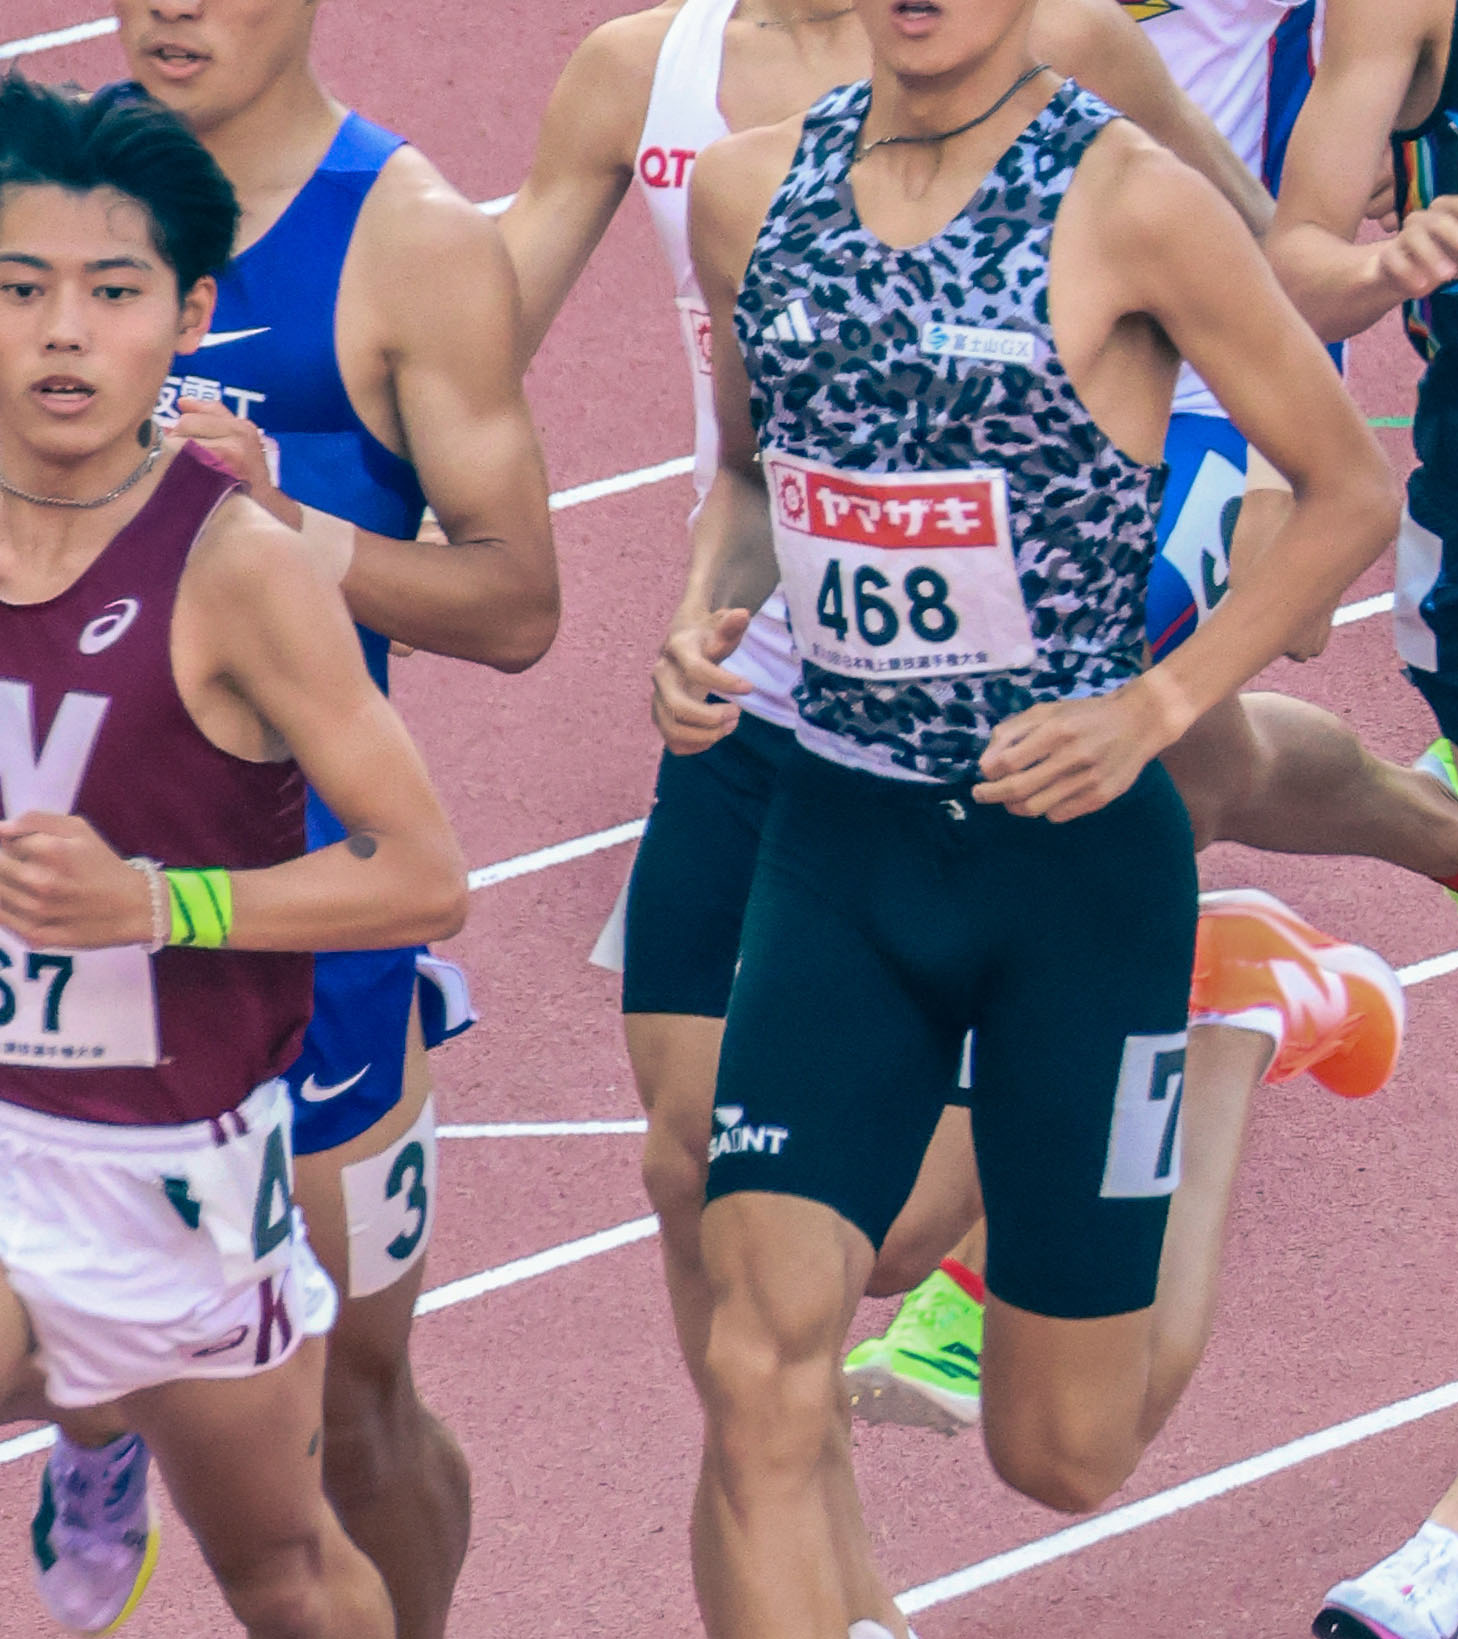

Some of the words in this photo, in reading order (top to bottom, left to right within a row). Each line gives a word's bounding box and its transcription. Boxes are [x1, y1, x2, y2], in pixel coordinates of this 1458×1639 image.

[816, 486, 982, 537] ヤマザキ
[816, 557, 960, 647] 468
[1148, 1047, 1188, 1181] 7
[384, 1140, 428, 1261] 3
